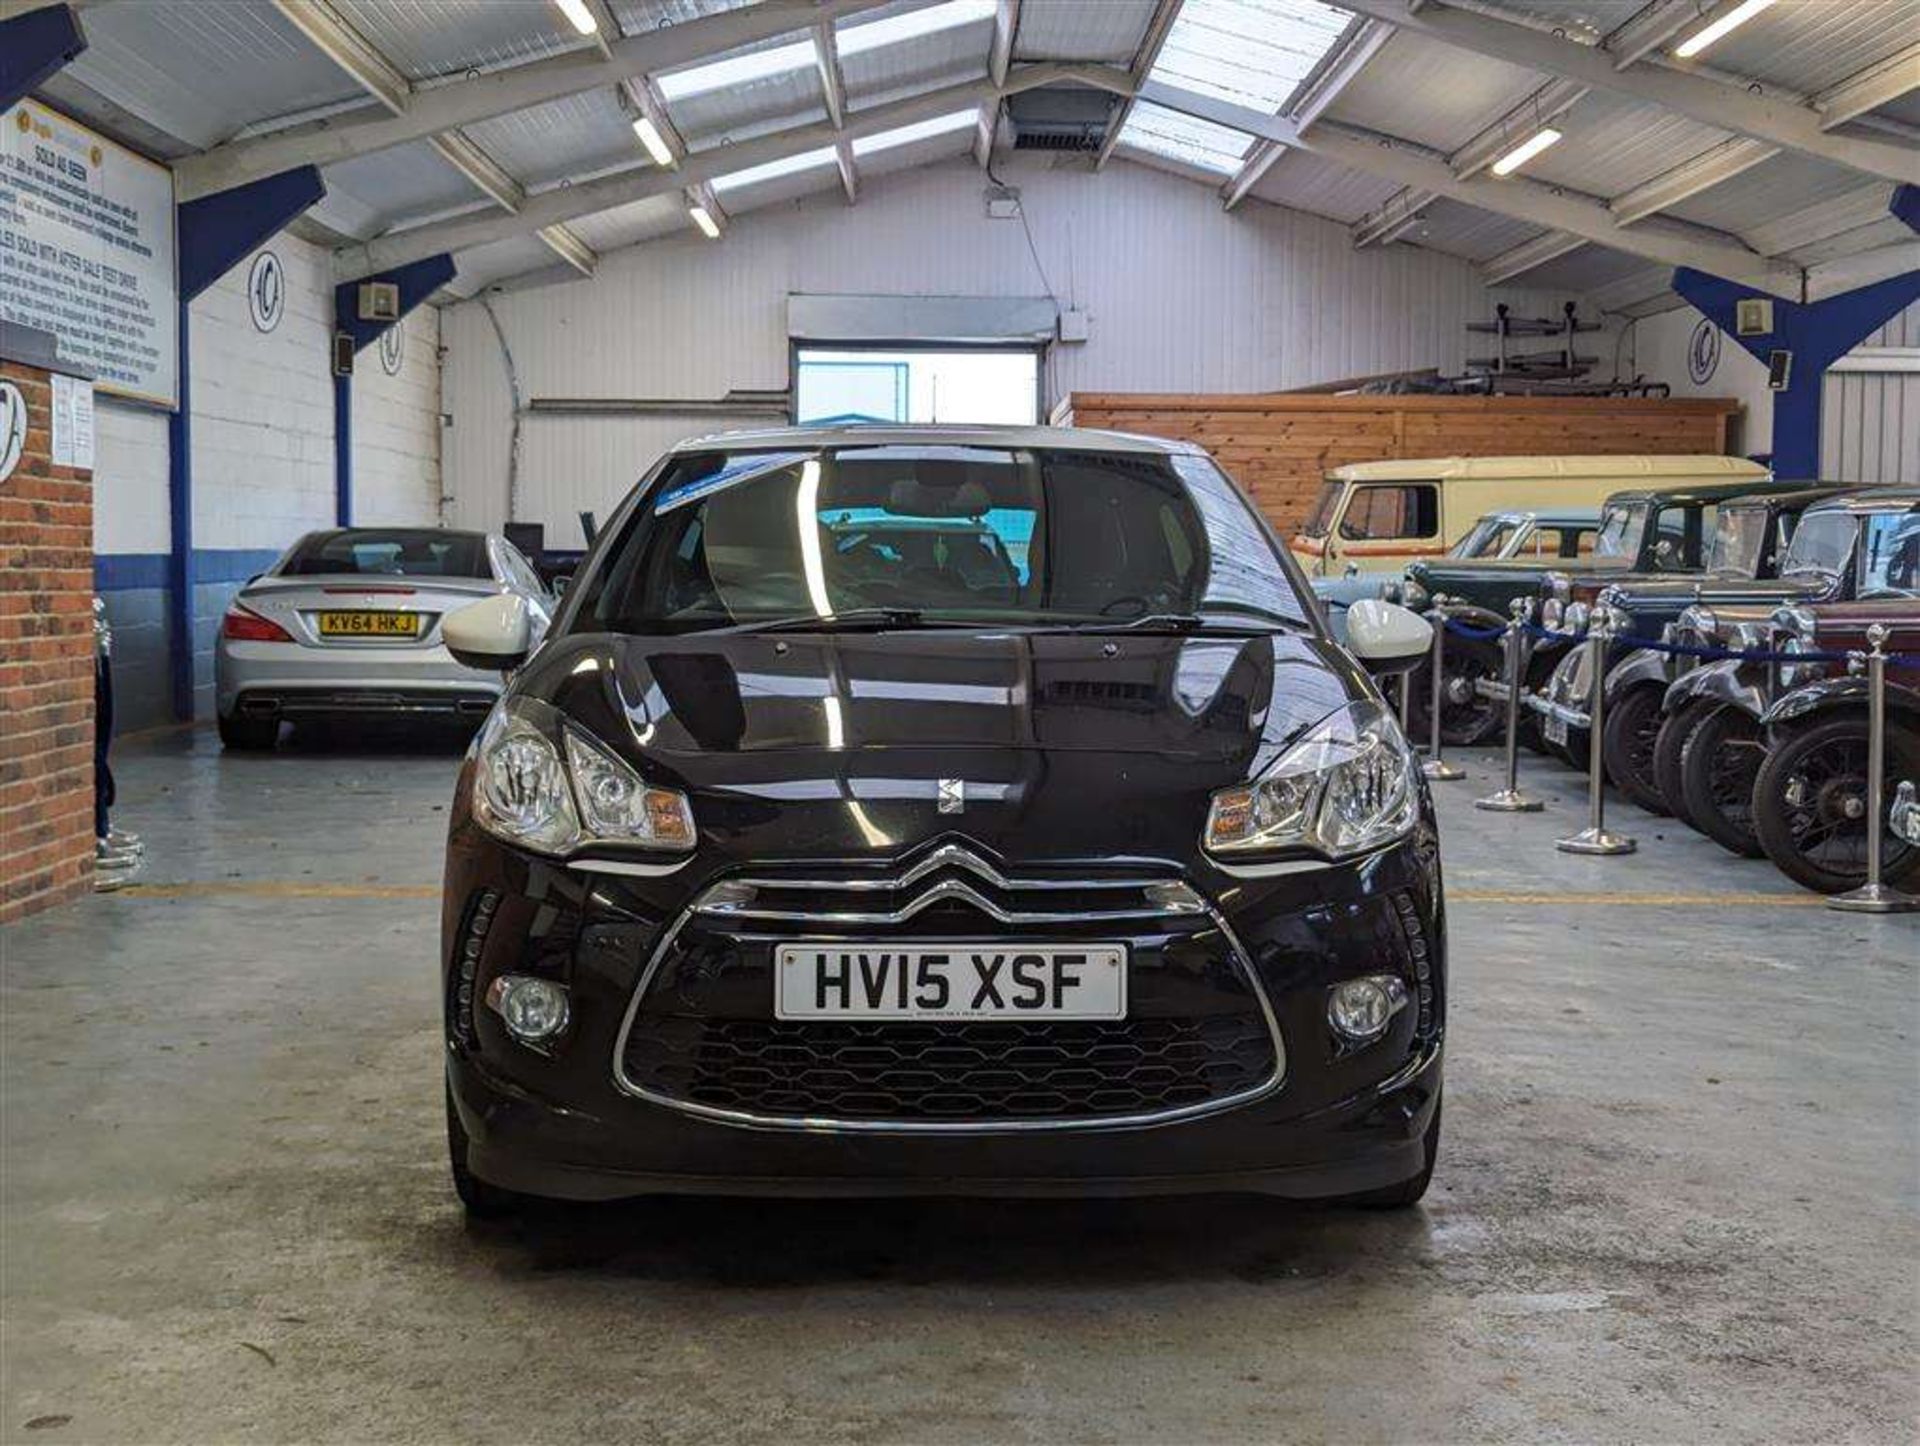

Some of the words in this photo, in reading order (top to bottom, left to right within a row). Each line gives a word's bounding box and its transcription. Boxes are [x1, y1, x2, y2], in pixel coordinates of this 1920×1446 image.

[377, 614, 412, 631] HKJ
[815, 953, 950, 1010] HV15
[970, 953, 1087, 1010] XSF
